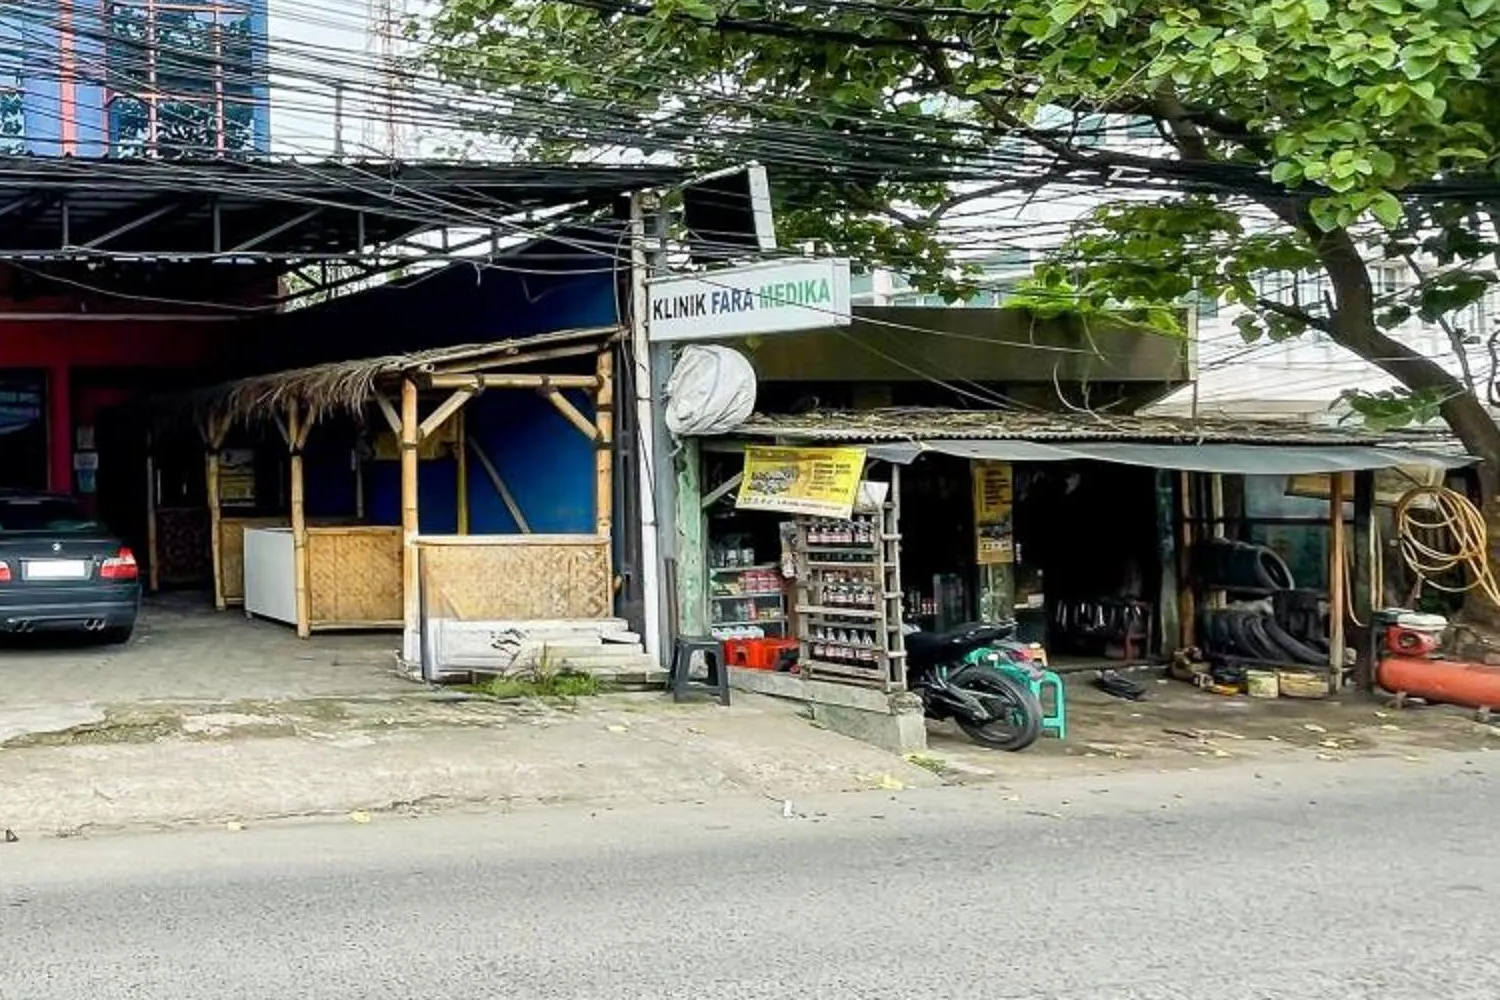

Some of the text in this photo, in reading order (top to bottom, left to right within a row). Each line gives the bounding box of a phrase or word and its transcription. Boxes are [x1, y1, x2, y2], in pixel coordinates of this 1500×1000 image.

[653, 278, 831, 321] KLINIK FARA MEDIKA
